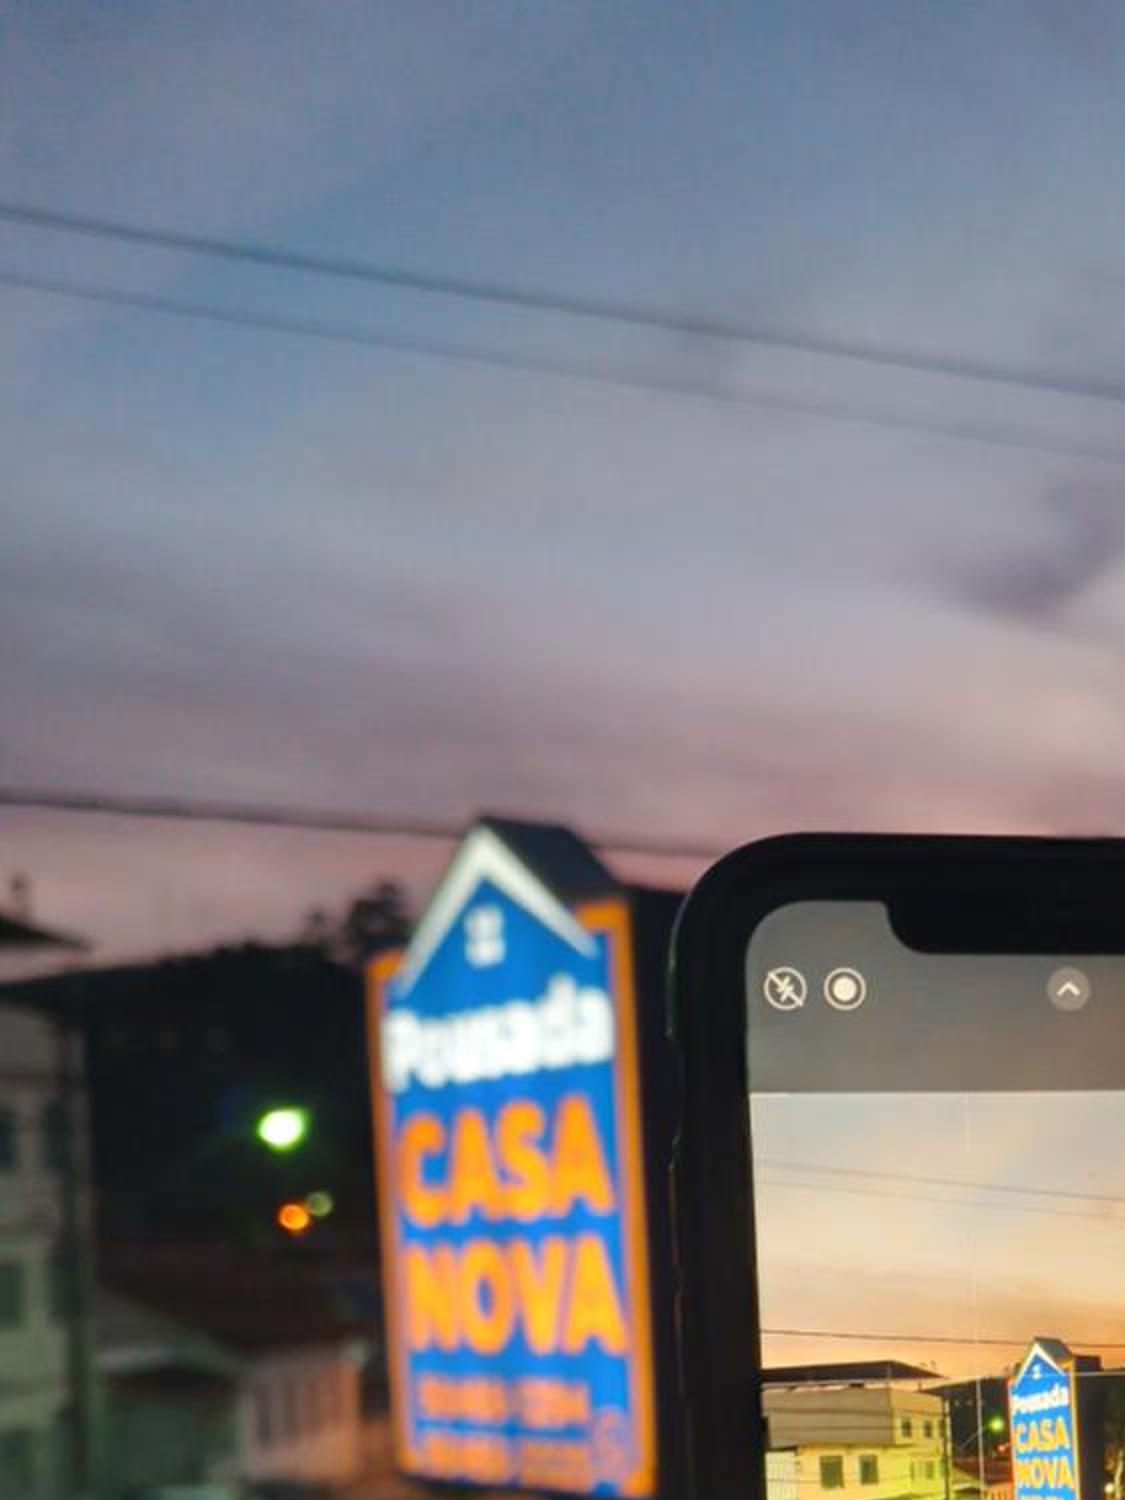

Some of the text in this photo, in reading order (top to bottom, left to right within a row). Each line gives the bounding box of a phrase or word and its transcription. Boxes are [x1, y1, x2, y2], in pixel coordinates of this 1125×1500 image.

[400, 1096, 613, 1226] CASA
[405, 1234, 627, 1354] NOVA
[1015, 1415, 1070, 1453] CASA
